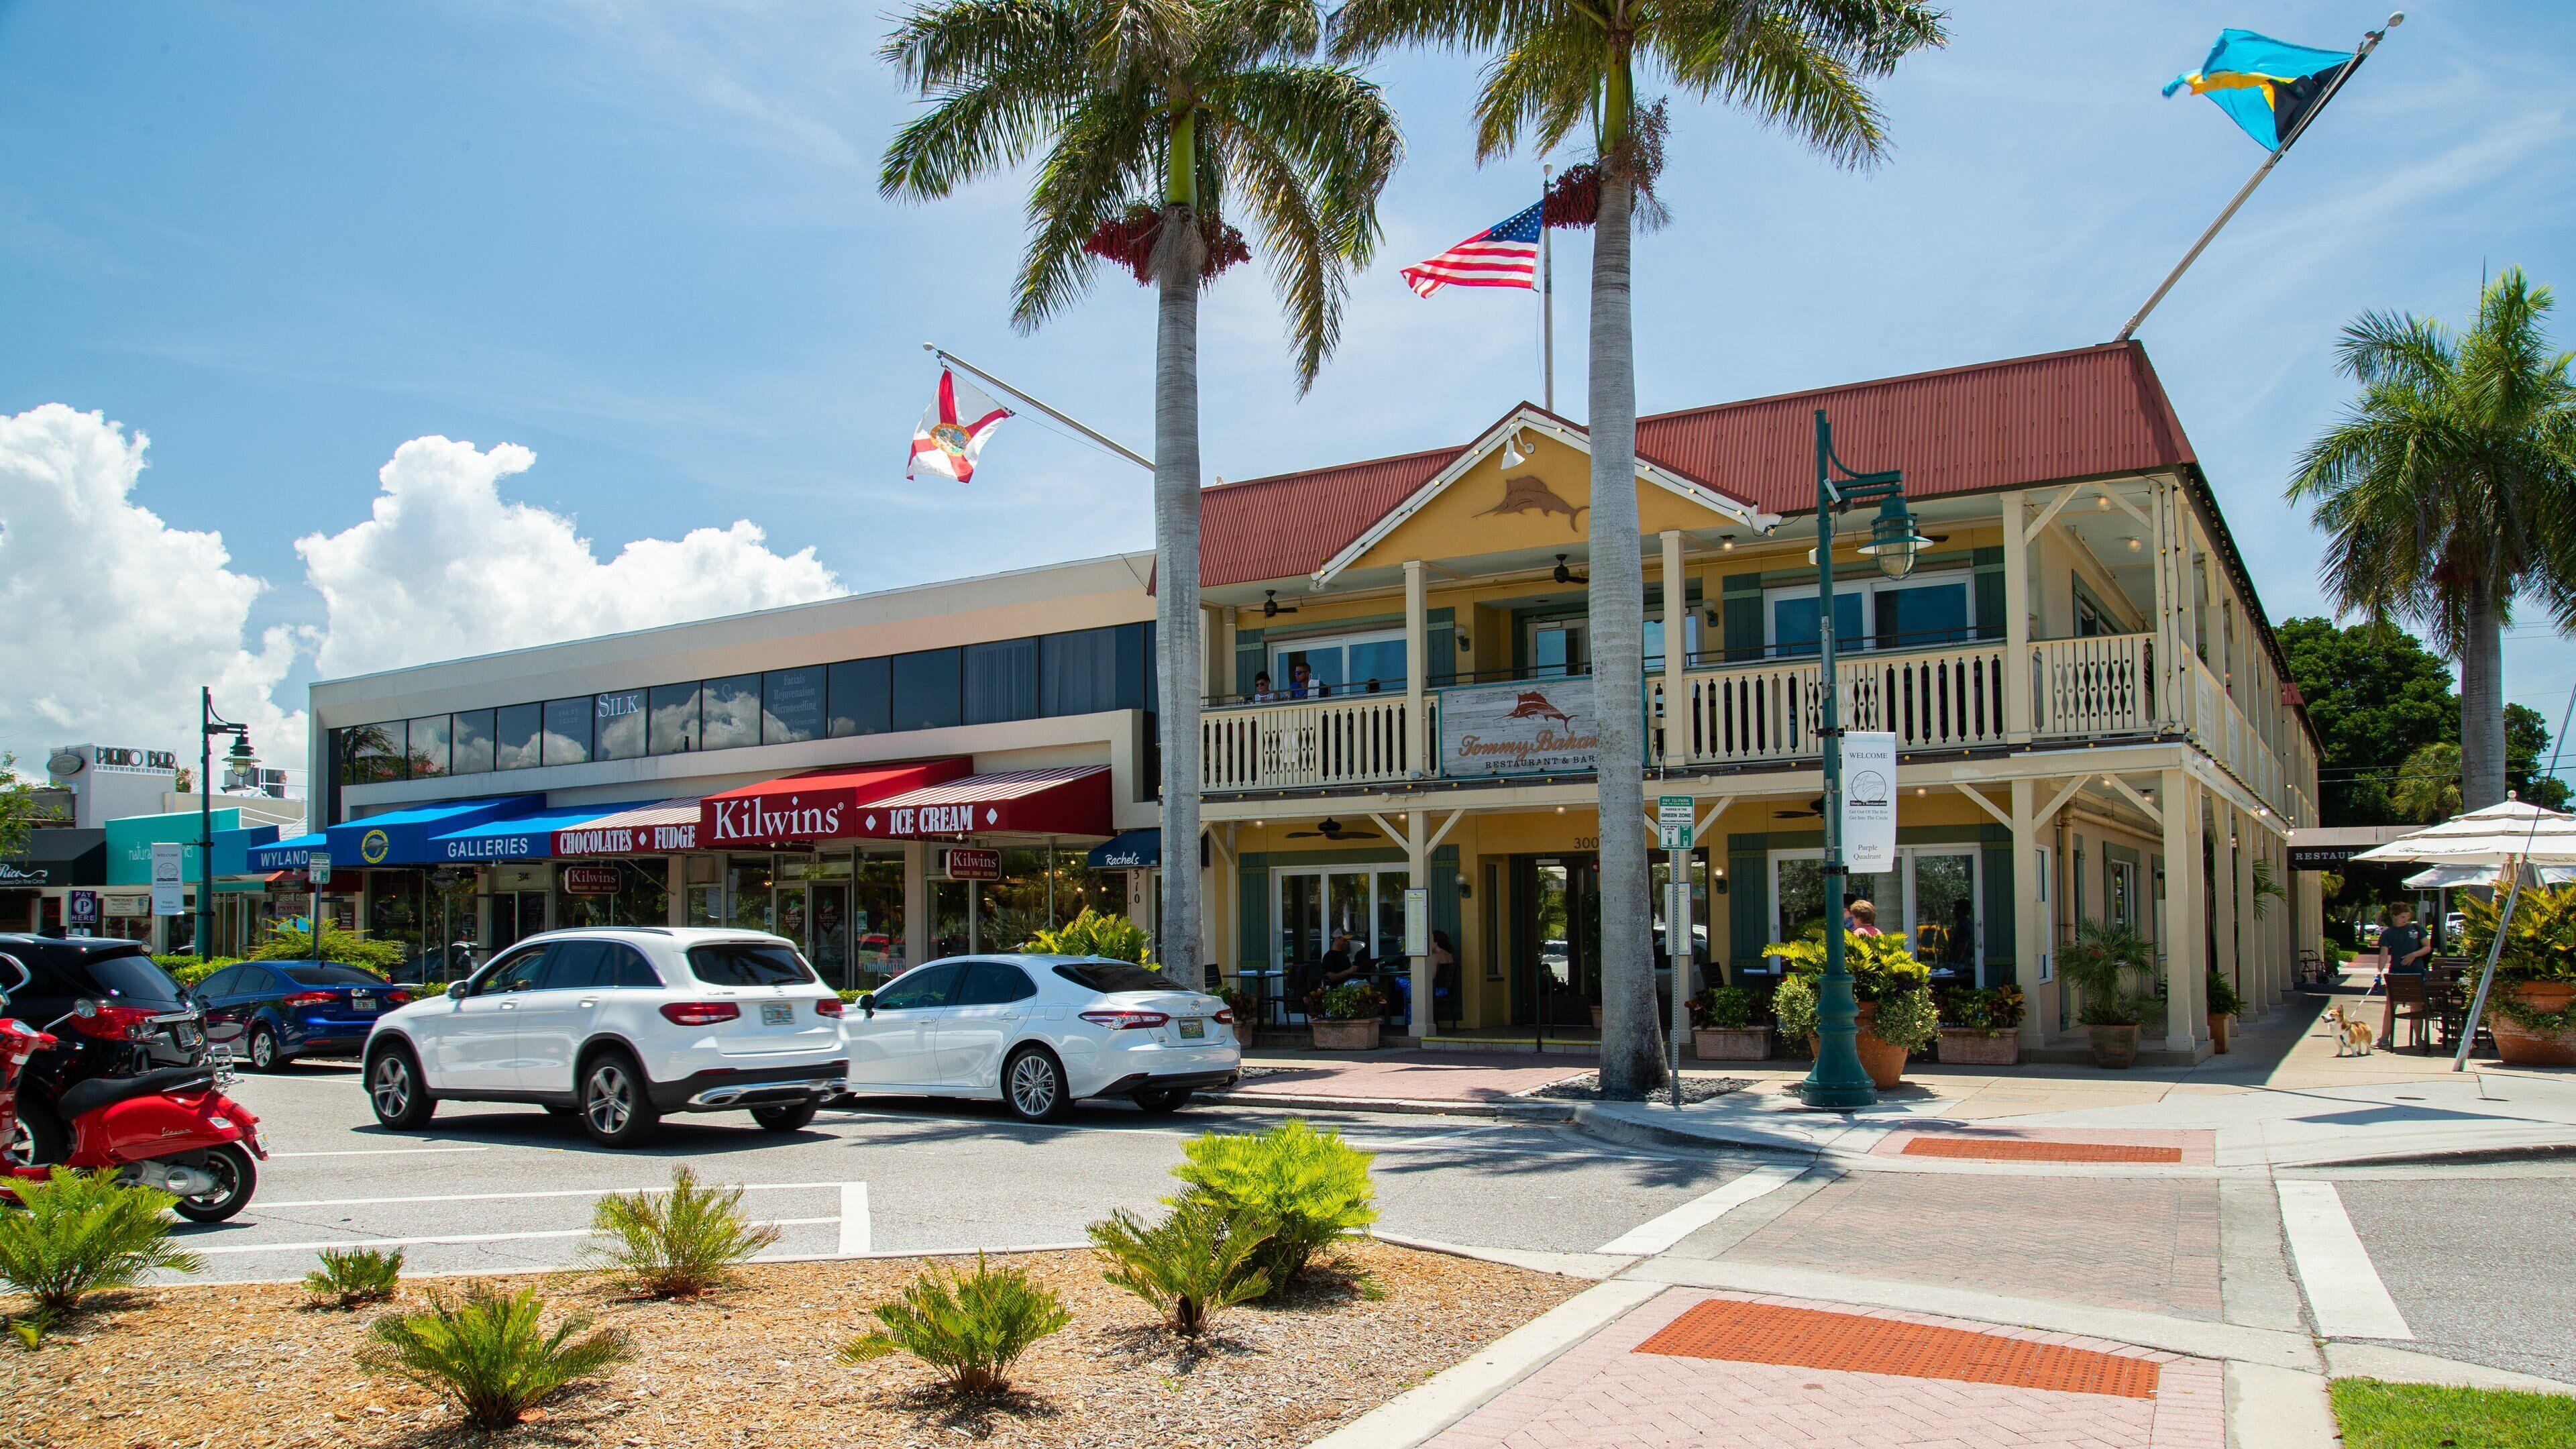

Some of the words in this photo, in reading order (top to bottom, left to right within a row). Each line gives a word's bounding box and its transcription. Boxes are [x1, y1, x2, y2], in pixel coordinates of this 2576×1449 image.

[784, 673, 806, 686] Facials
[774, 686, 815, 701] Rejuvenation
[598, 693, 639, 718] SILK
[772, 700, 817, 714] Microneedling
[1458, 735, 1531, 761] Tommy
[97, 747, 143, 767] PIANO
[148, 751, 176, 769] BAR
[1485, 757, 1558, 769] RESTAURANT
[1573, 755, 1595, 763] BAR
[890, 808, 914, 835] ICE
[919, 805, 973, 833] CREAM
[559, 828, 632, 855] CHOCOLATES
[654, 824, 696, 849] FUDGE
[1574, 837, 1599, 849] 300
[447, 837, 528, 857] GALLERIES
[1858, 844, 1878, 852] Purple
[261, 850, 309, 867] WYLAND
[1105, 851, 1140, 865] Rachel's
[2295, 851, 2362, 860] RESTAUR
[517, 873, 529, 881] 314
[863, 962, 903, 973] CHOCOLATES
